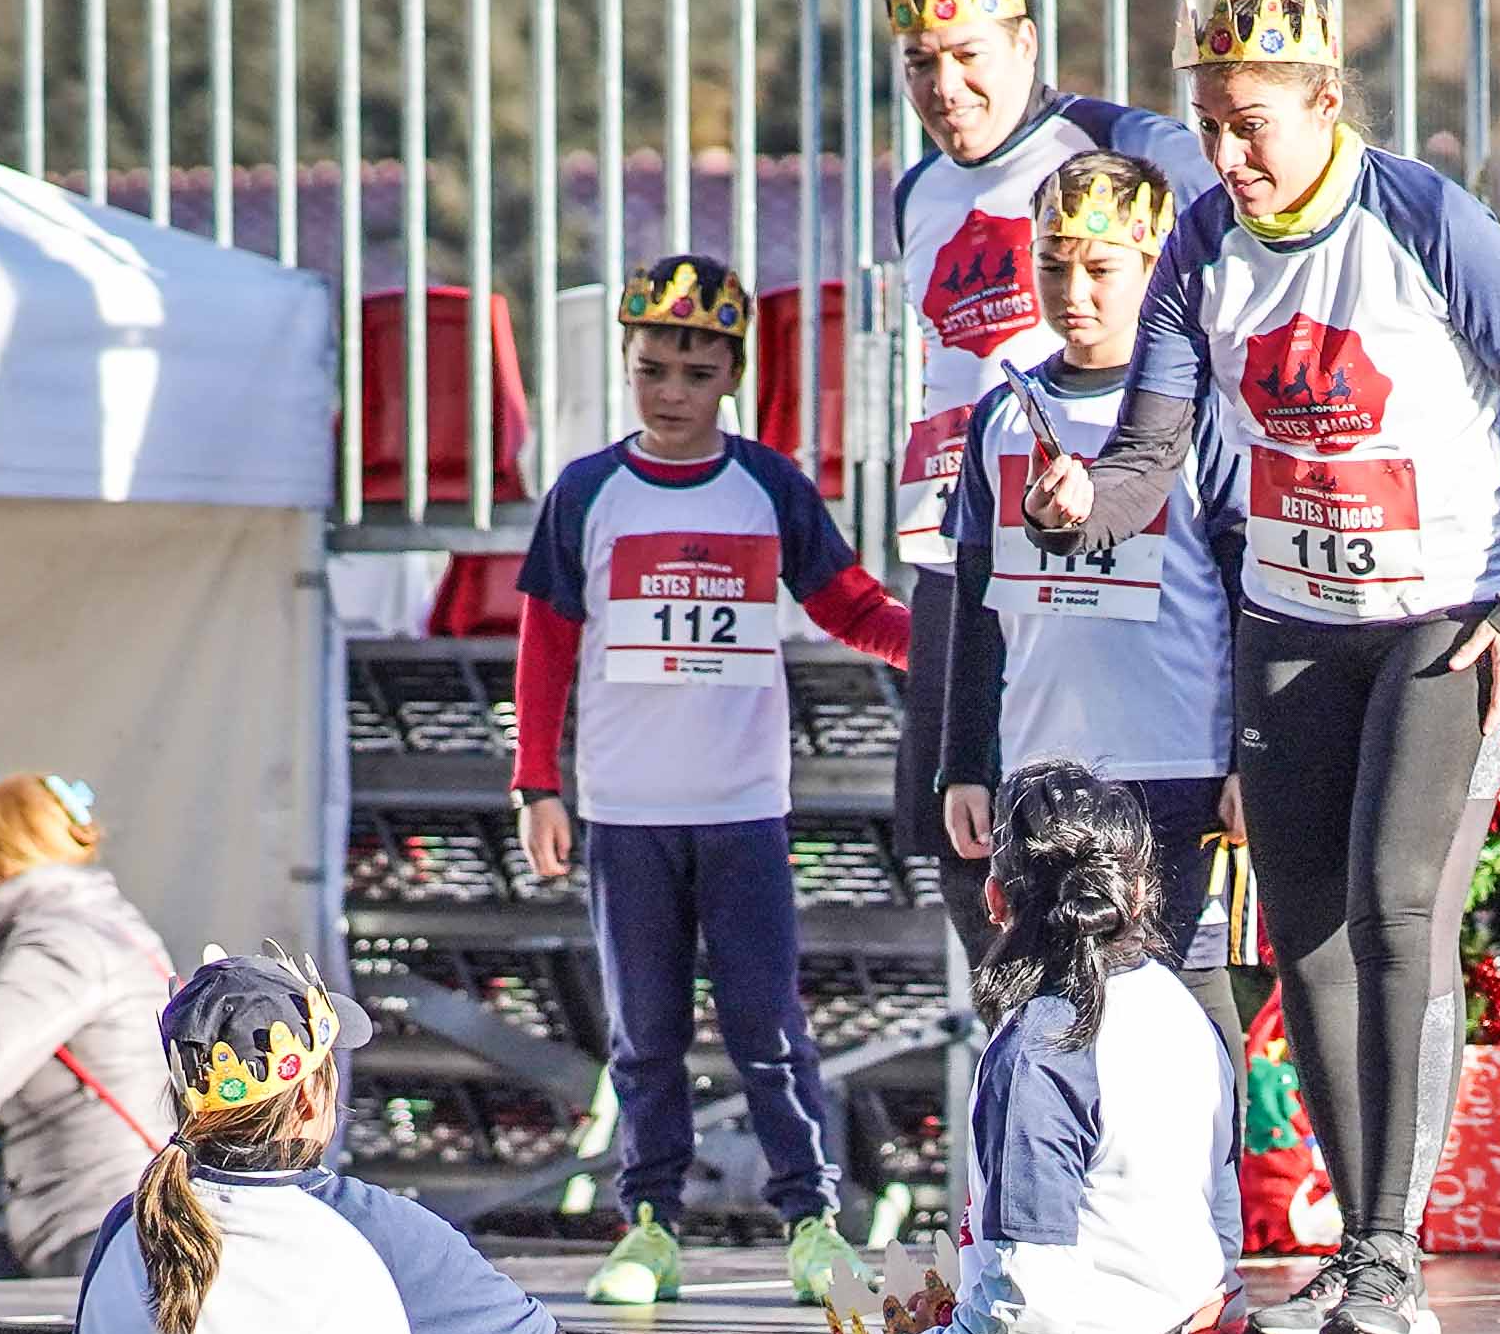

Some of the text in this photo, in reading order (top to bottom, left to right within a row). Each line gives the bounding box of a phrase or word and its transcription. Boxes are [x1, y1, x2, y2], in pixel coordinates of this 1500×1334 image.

[1281, 495, 1385, 530] REYES MAGOS
[1292, 529, 1376, 576] 113
[653, 604, 738, 643] 112
